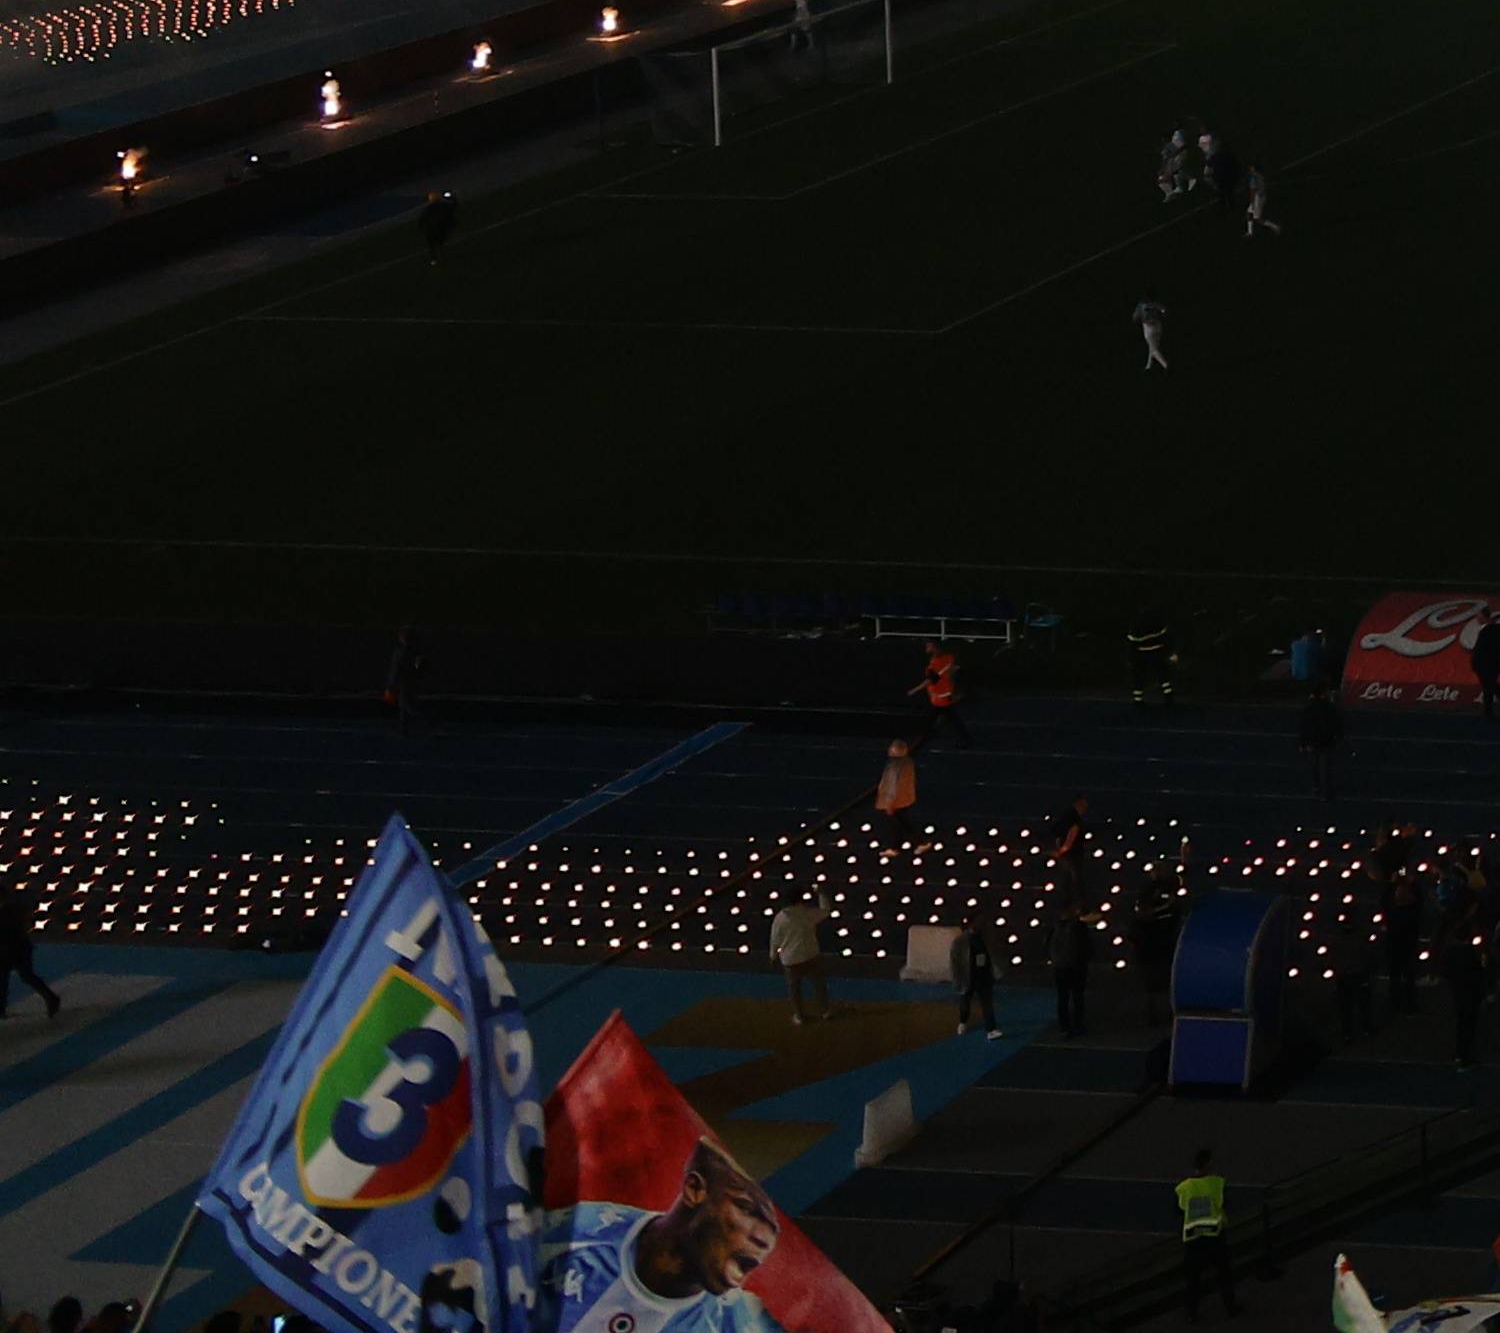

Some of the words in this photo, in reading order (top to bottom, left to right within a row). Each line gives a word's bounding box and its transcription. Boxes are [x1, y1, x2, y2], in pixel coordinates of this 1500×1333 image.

[1359, 683, 1402, 701] Lete
[1416, 685, 1460, 703] Lete
[331, 1027, 462, 1165] 3
